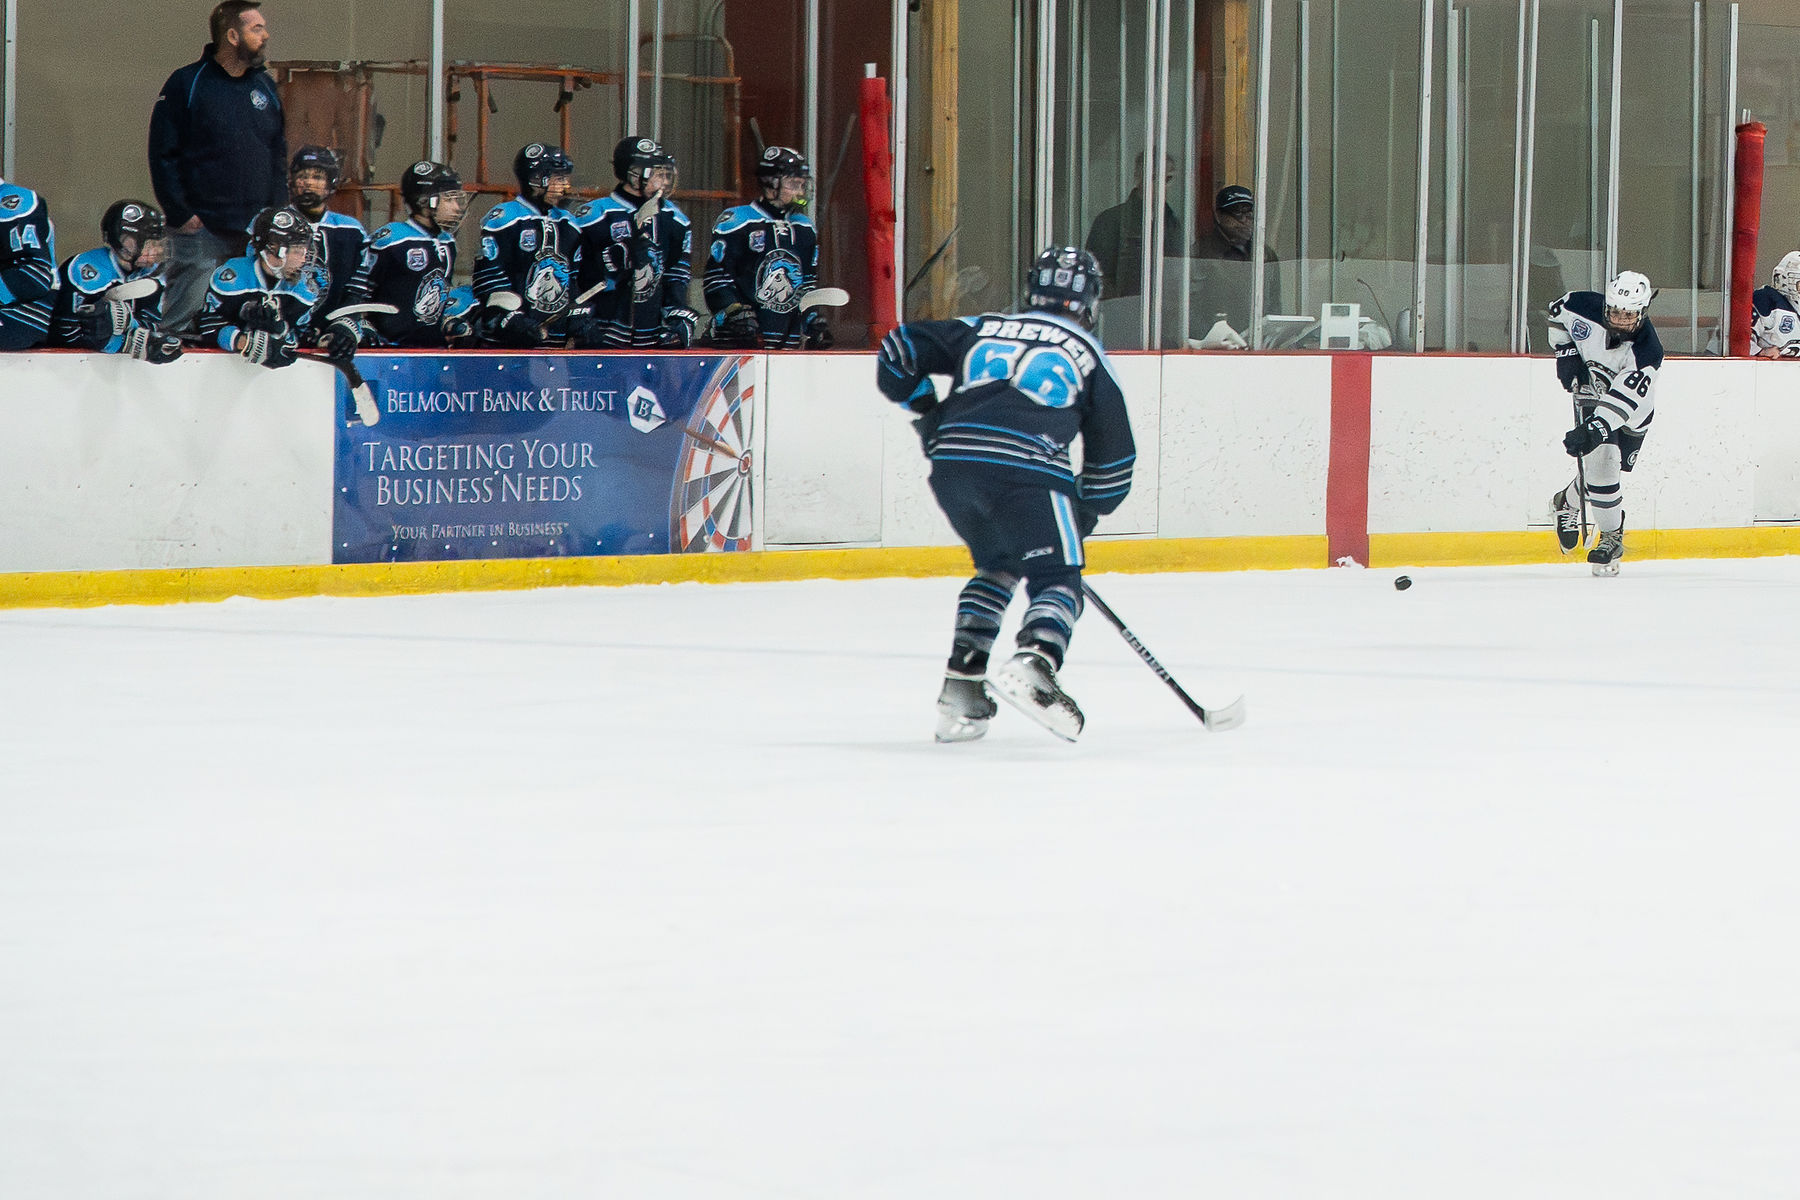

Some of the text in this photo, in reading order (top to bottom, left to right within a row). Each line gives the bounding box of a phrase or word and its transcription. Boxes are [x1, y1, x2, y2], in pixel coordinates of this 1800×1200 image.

[9, 223, 41, 252] 14
[977, 319, 1099, 379] BREWER
[1623, 370, 1652, 398] 86
[387, 388, 617, 414] BELMONT BANK & TRUST
[362, 439, 598, 473] TARGETING YOUR
[376, 473, 582, 507] BUSINESS NEEDS
[391, 524, 427, 542] YOUR
